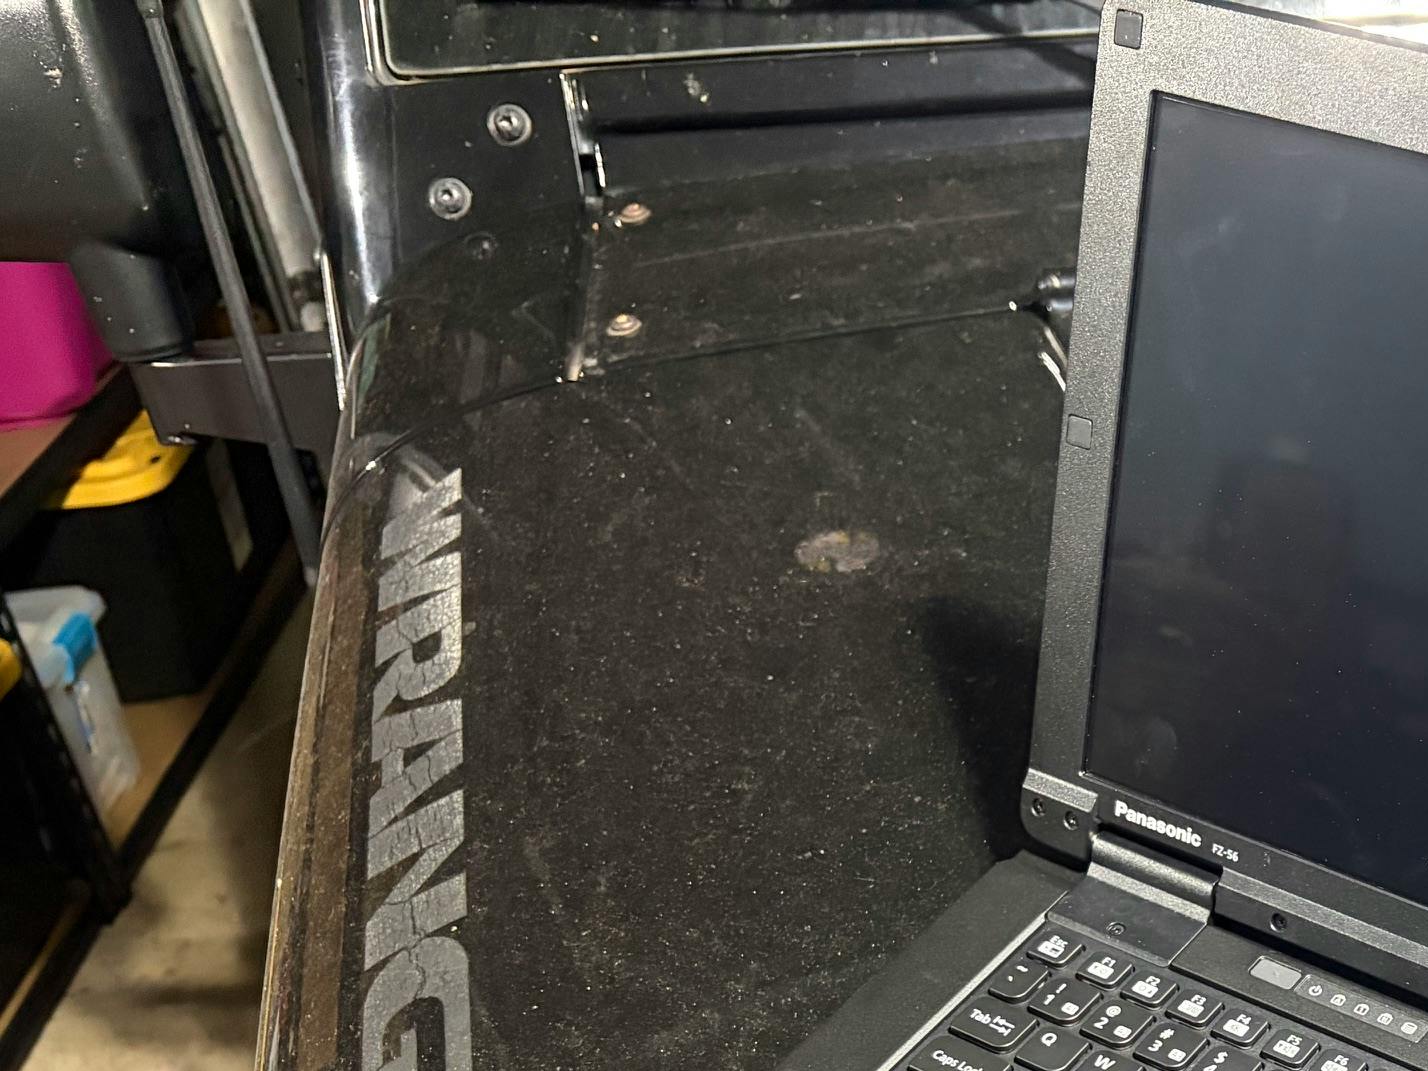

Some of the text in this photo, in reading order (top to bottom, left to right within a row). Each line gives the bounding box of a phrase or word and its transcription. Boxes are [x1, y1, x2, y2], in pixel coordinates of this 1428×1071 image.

[1114, 800, 1240, 862] Panasonic FZ-56
[1102, 956, 1117, 968] F1
[1147, 975, 1161, 987] F2
[1043, 994, 1055, 1005] 1
[1191, 994, 1207, 1006] F3
[969, 1008, 991, 1024] Tab
[1105, 1005, 1121, 1018] @
[1093, 1016, 1109, 1029] 2
[1236, 1014, 1252, 1026] F4
[1041, 1032, 1058, 1047] Q
[1159, 1028, 1176, 1040] #
[1286, 1034, 1303, 1046] F5
[1147, 1040, 1163, 1052] 3
[931, 1050, 960, 1067] Caps
[1094, 1054, 1116, 1071] W
[1333, 1054, 1350, 1066] F6
